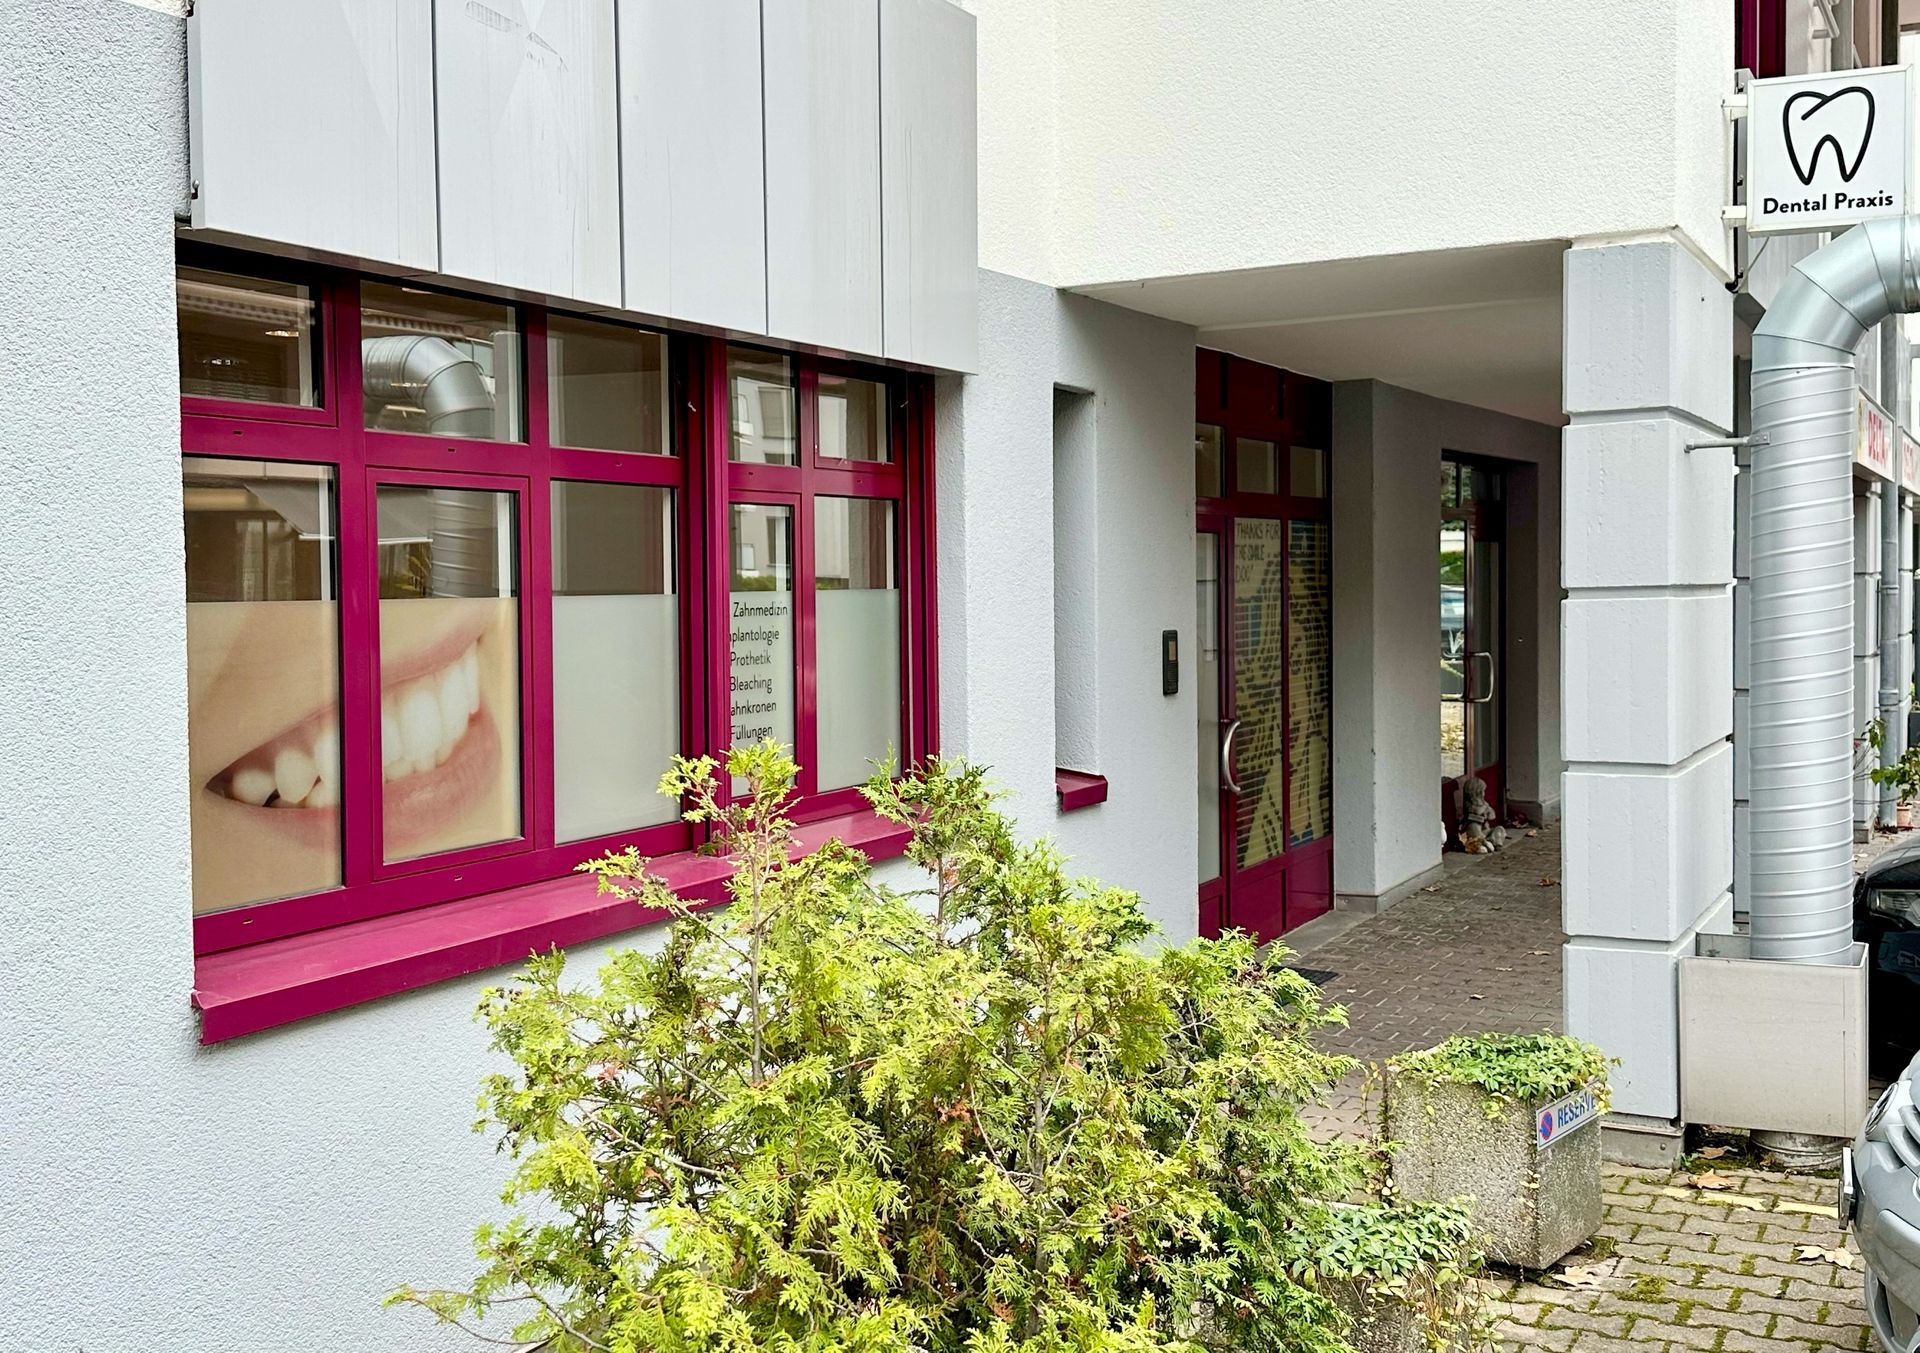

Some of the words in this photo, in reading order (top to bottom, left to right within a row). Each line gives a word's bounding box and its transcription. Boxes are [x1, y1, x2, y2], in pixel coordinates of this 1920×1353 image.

[1763, 194, 1827, 214] Dental
[1834, 190, 1894, 210] Praxis
[733, 601, 788, 617] Zahnmedizin
[729, 626, 780, 648] plantologie
[730, 650, 771, 666] Prothetik
[730, 675, 772, 694] Bleaching
[731, 700, 777, 716] ahnkronen
[731, 725, 773, 743] Füllungen
